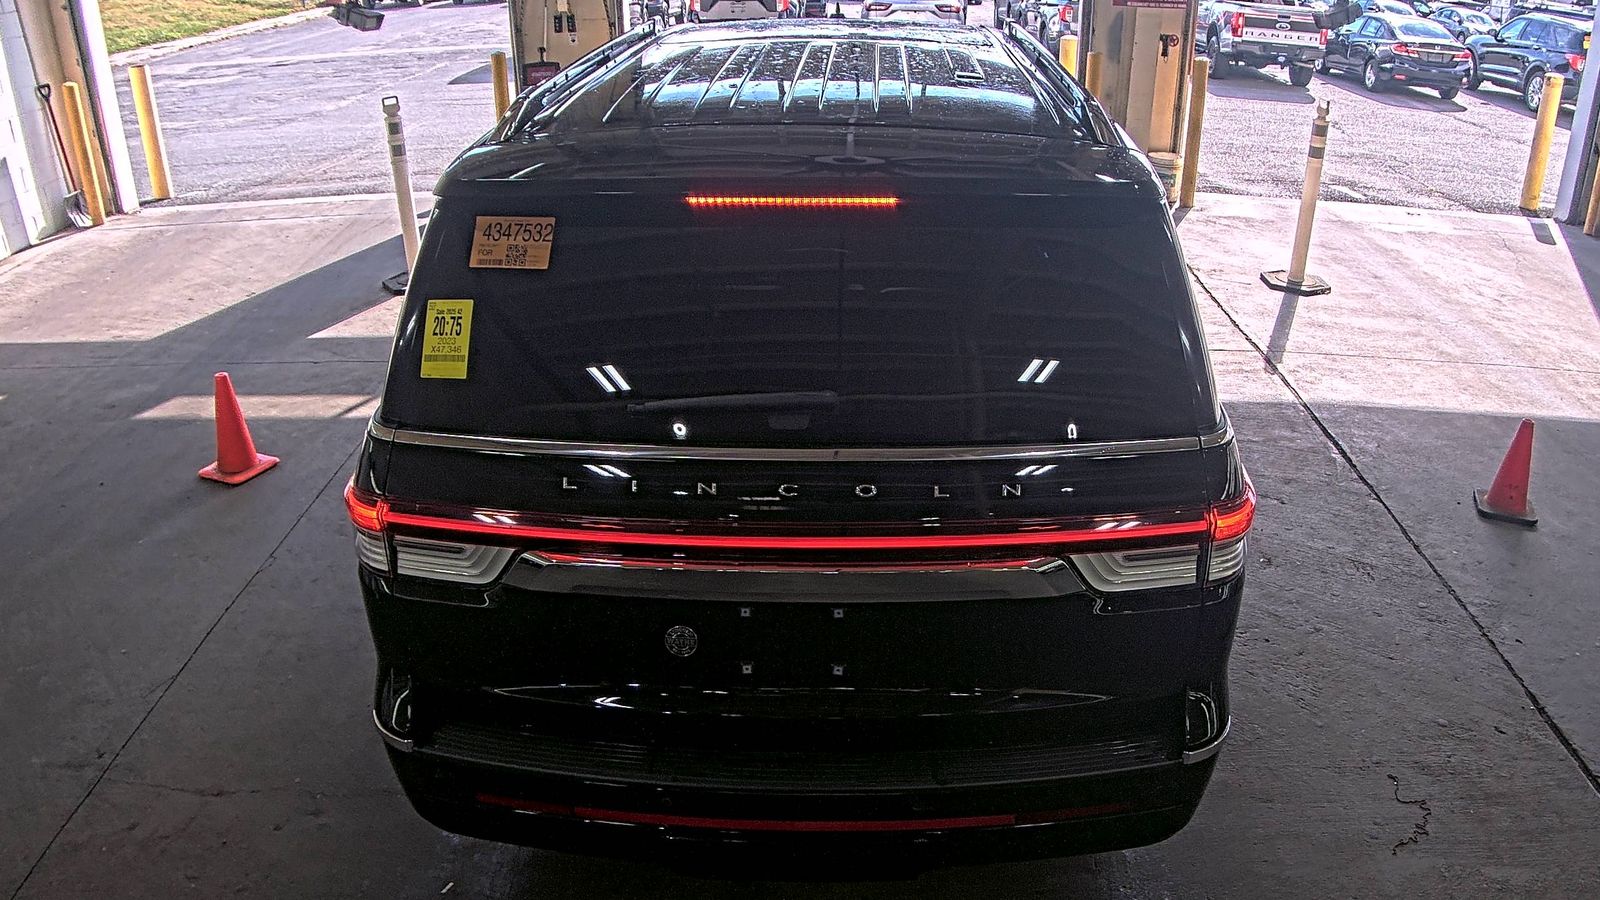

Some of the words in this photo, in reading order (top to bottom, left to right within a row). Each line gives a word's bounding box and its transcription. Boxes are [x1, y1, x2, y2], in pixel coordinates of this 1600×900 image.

[1245, 30, 1318, 41] RANGER
[483, 222, 554, 243] 4347532
[432, 316, 463, 336] 20:75
[437, 337, 457, 345] 2023
[563, 476, 1022, 498] LINCOLN
